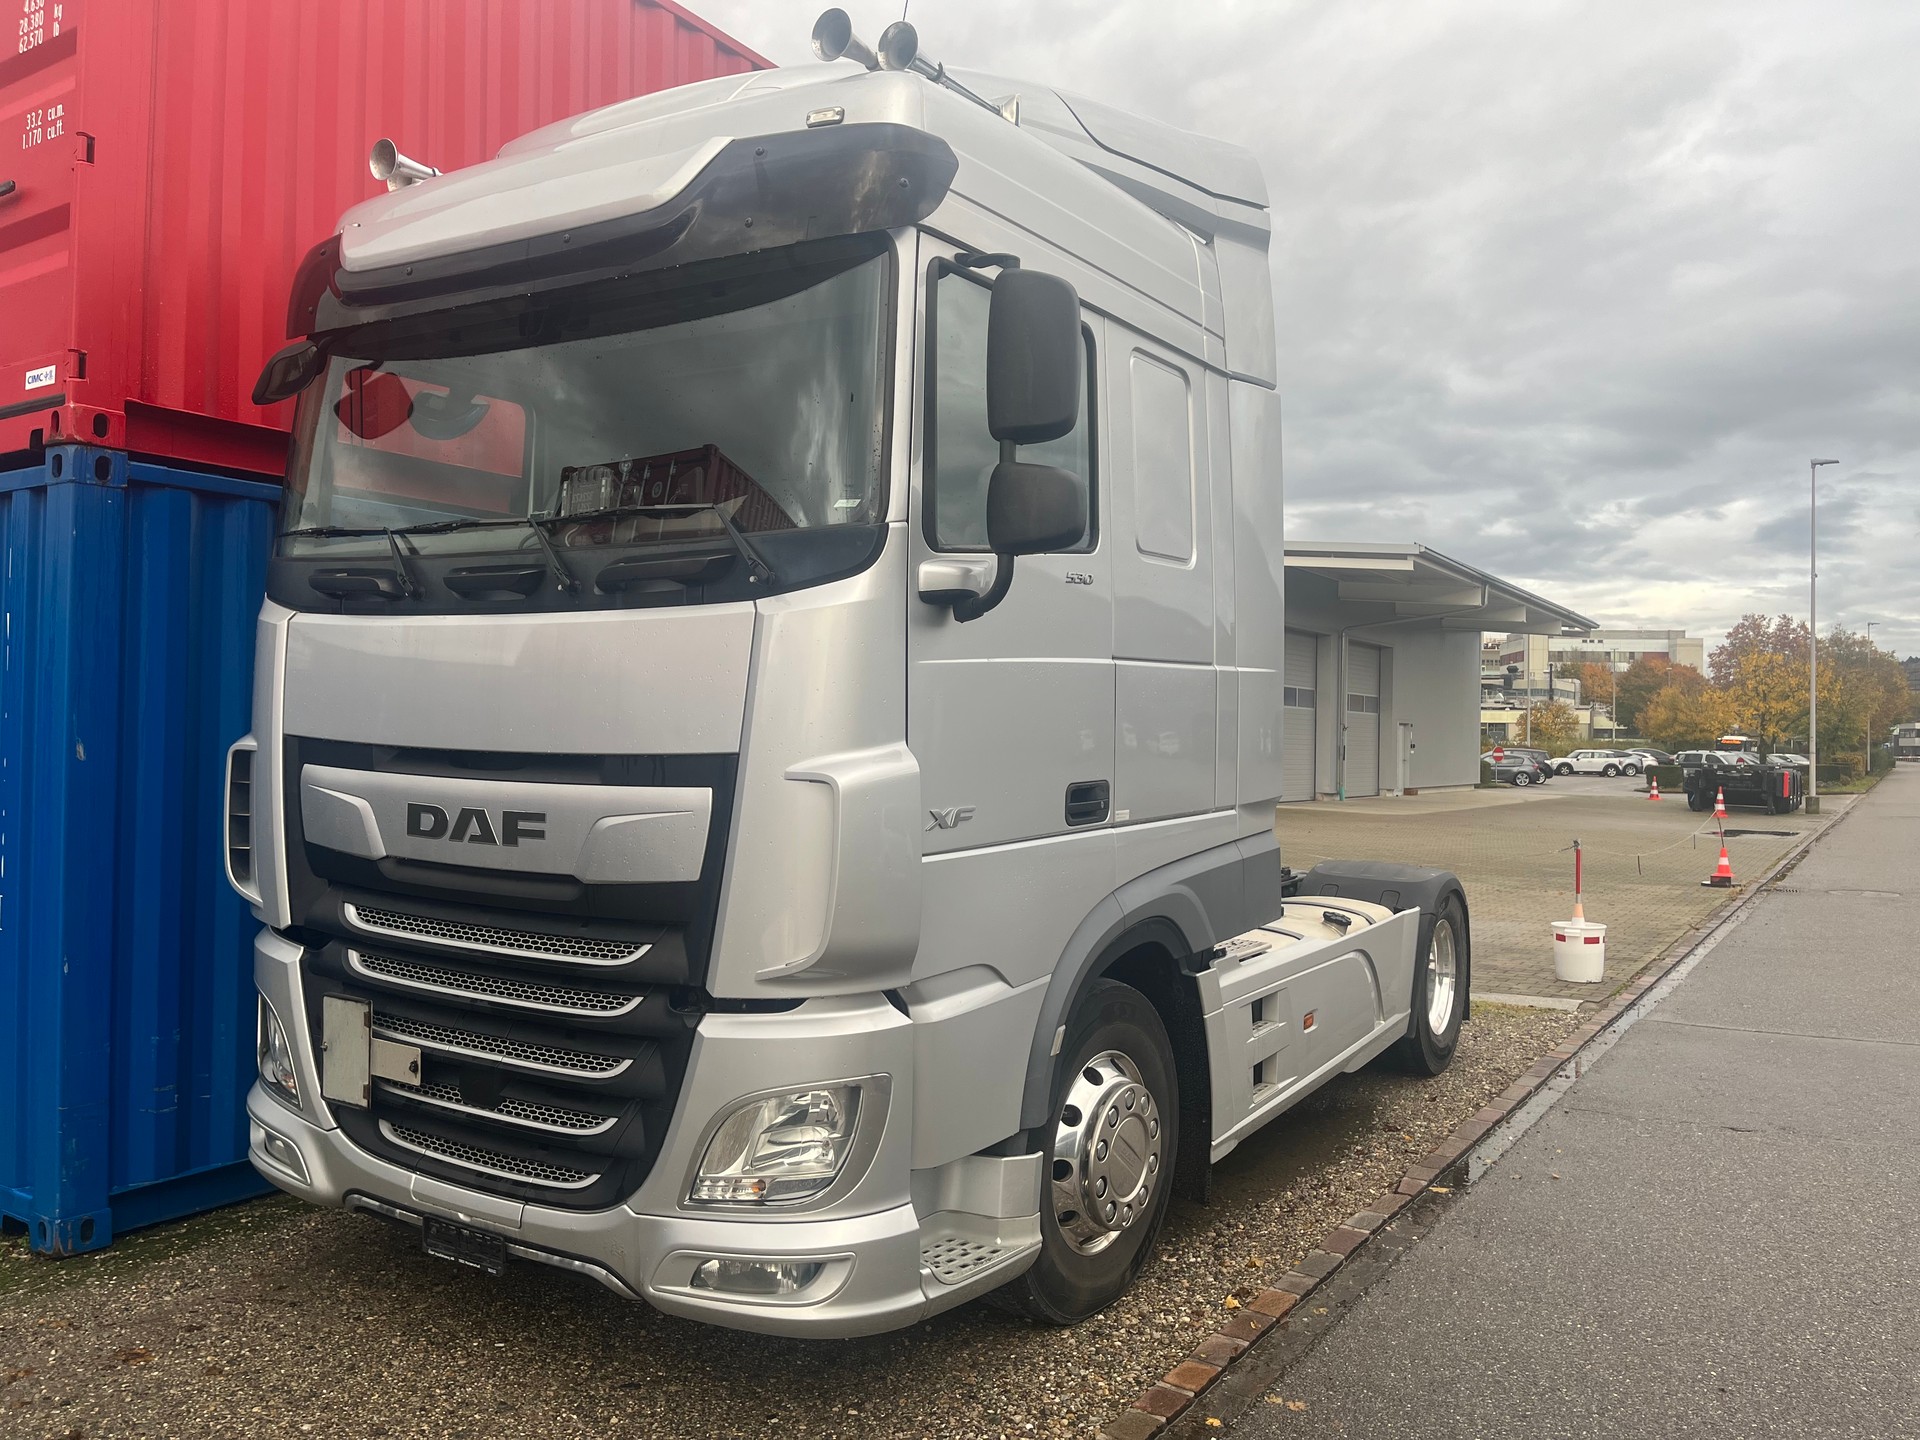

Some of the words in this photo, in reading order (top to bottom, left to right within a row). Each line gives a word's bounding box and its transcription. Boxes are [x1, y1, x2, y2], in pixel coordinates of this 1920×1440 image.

[19, 10, 44, 36] 28.380
[53, 4, 62, 21] kg
[19, 28, 43, 54] 62.570
[53, 21, 59, 37] lb
[26, 109, 42, 130] 33.2
[47, 104, 64, 121] cu.m.
[22, 127, 42, 150] 1.170
[47, 119, 64, 140] cu.ft.
[27, 373, 43, 384] CIMC
[407, 801, 546, 847] DAF
[925, 805, 976, 832] XF
